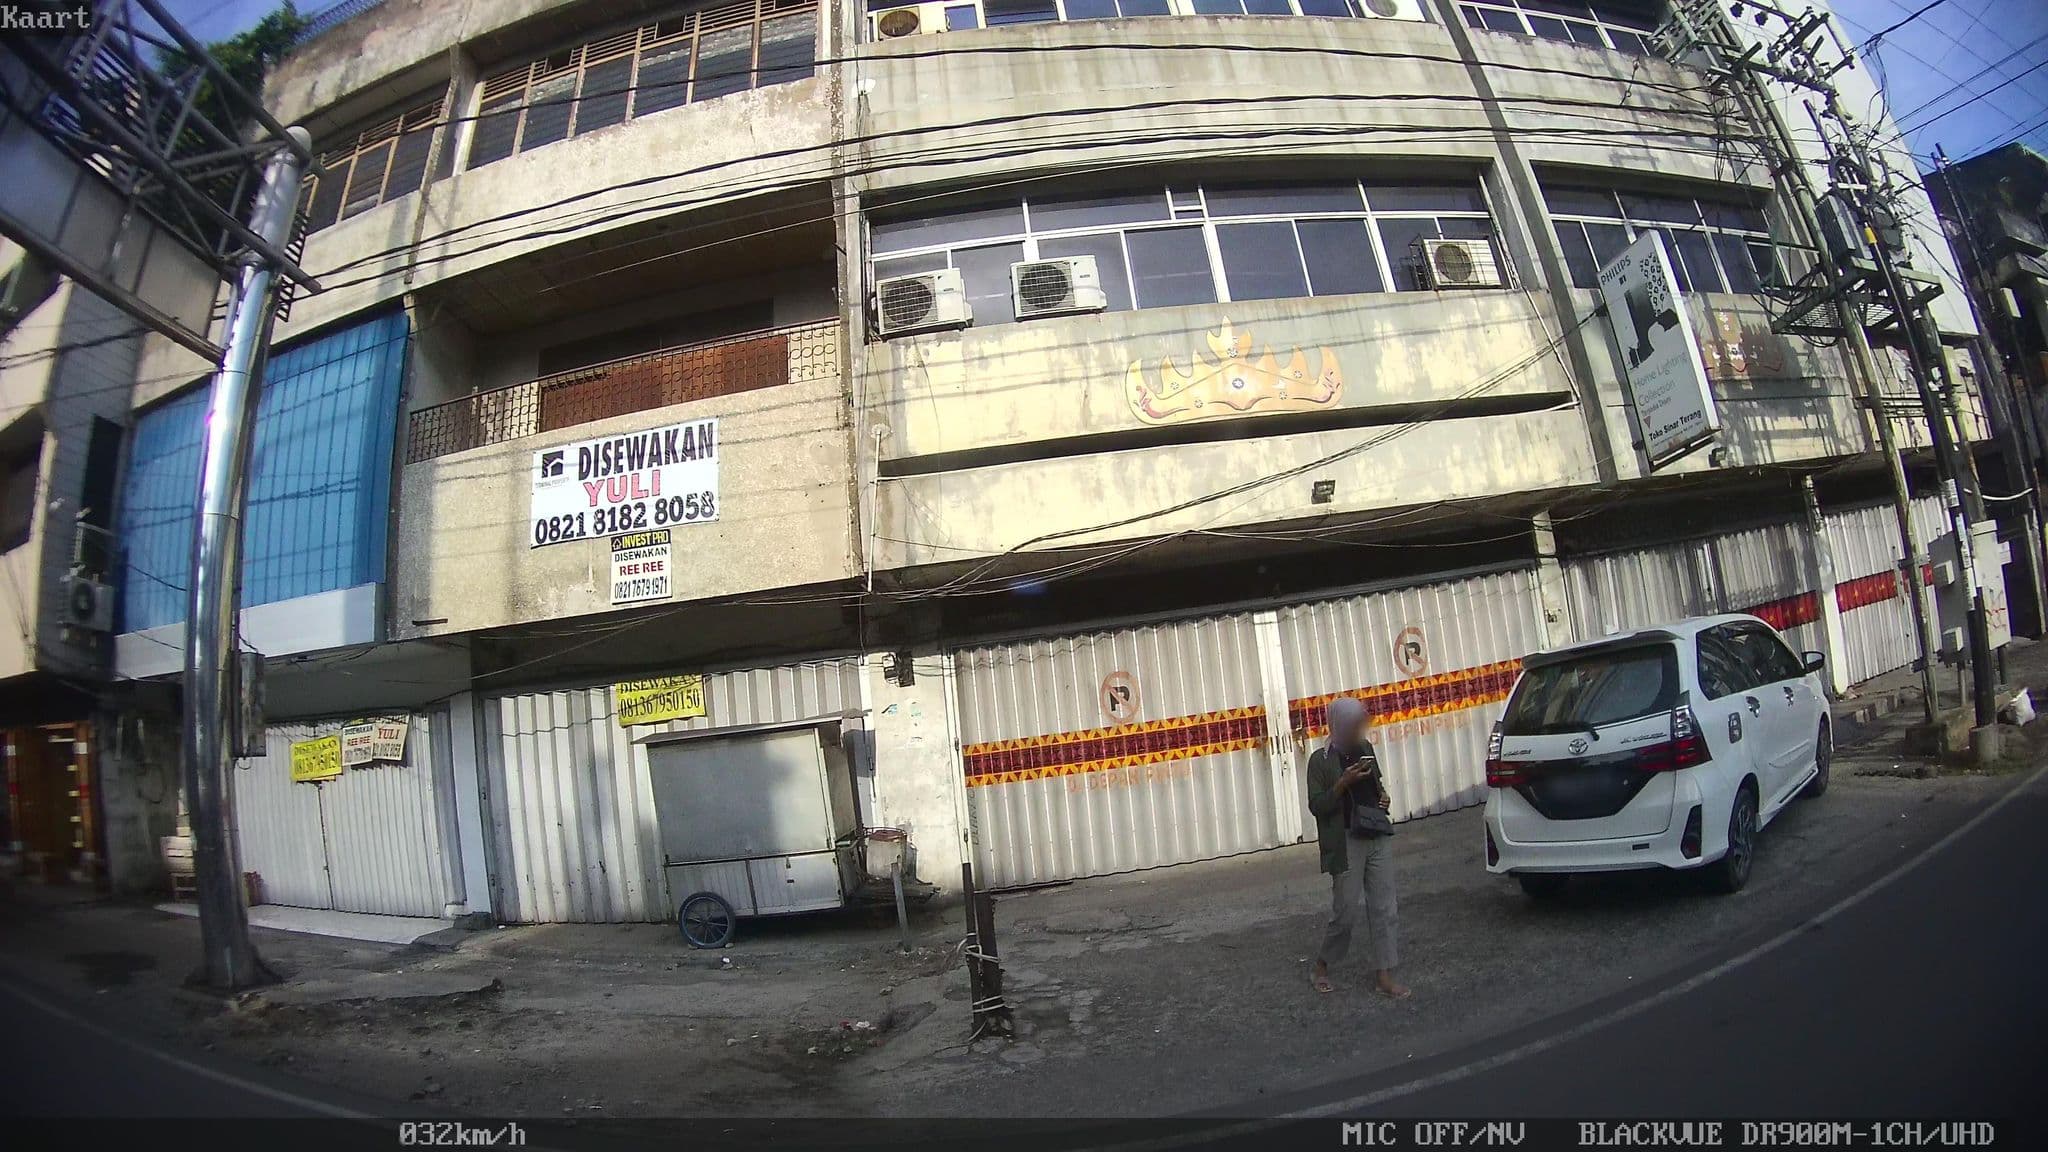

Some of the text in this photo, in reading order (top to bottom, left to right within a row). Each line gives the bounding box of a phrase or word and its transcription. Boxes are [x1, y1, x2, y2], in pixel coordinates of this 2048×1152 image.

[1601, 255, 1631, 285] PHILIPS
[1634, 352, 1688, 390] Home Lighting
[1638, 380, 1677, 407] Collection
[1648, 429, 1664, 441] Toko
[1664, 419, 1679, 433] Sinar
[1679, 409, 1702, 425] Terang
[578, 422, 714, 481] DISEWAKAN
[583, 469, 661, 507] YULI
[535, 491, 715, 545] 0821 8182 8058
[614, 546, 668, 562] DISEWAKAN
[622, 530, 669, 548] INVEST PRO
[619, 561, 664, 576] REE REE
[620, 688, 700, 719] 081367950150
[347, 735, 371, 746] REE REE
[378, 728, 400, 740] YULI
